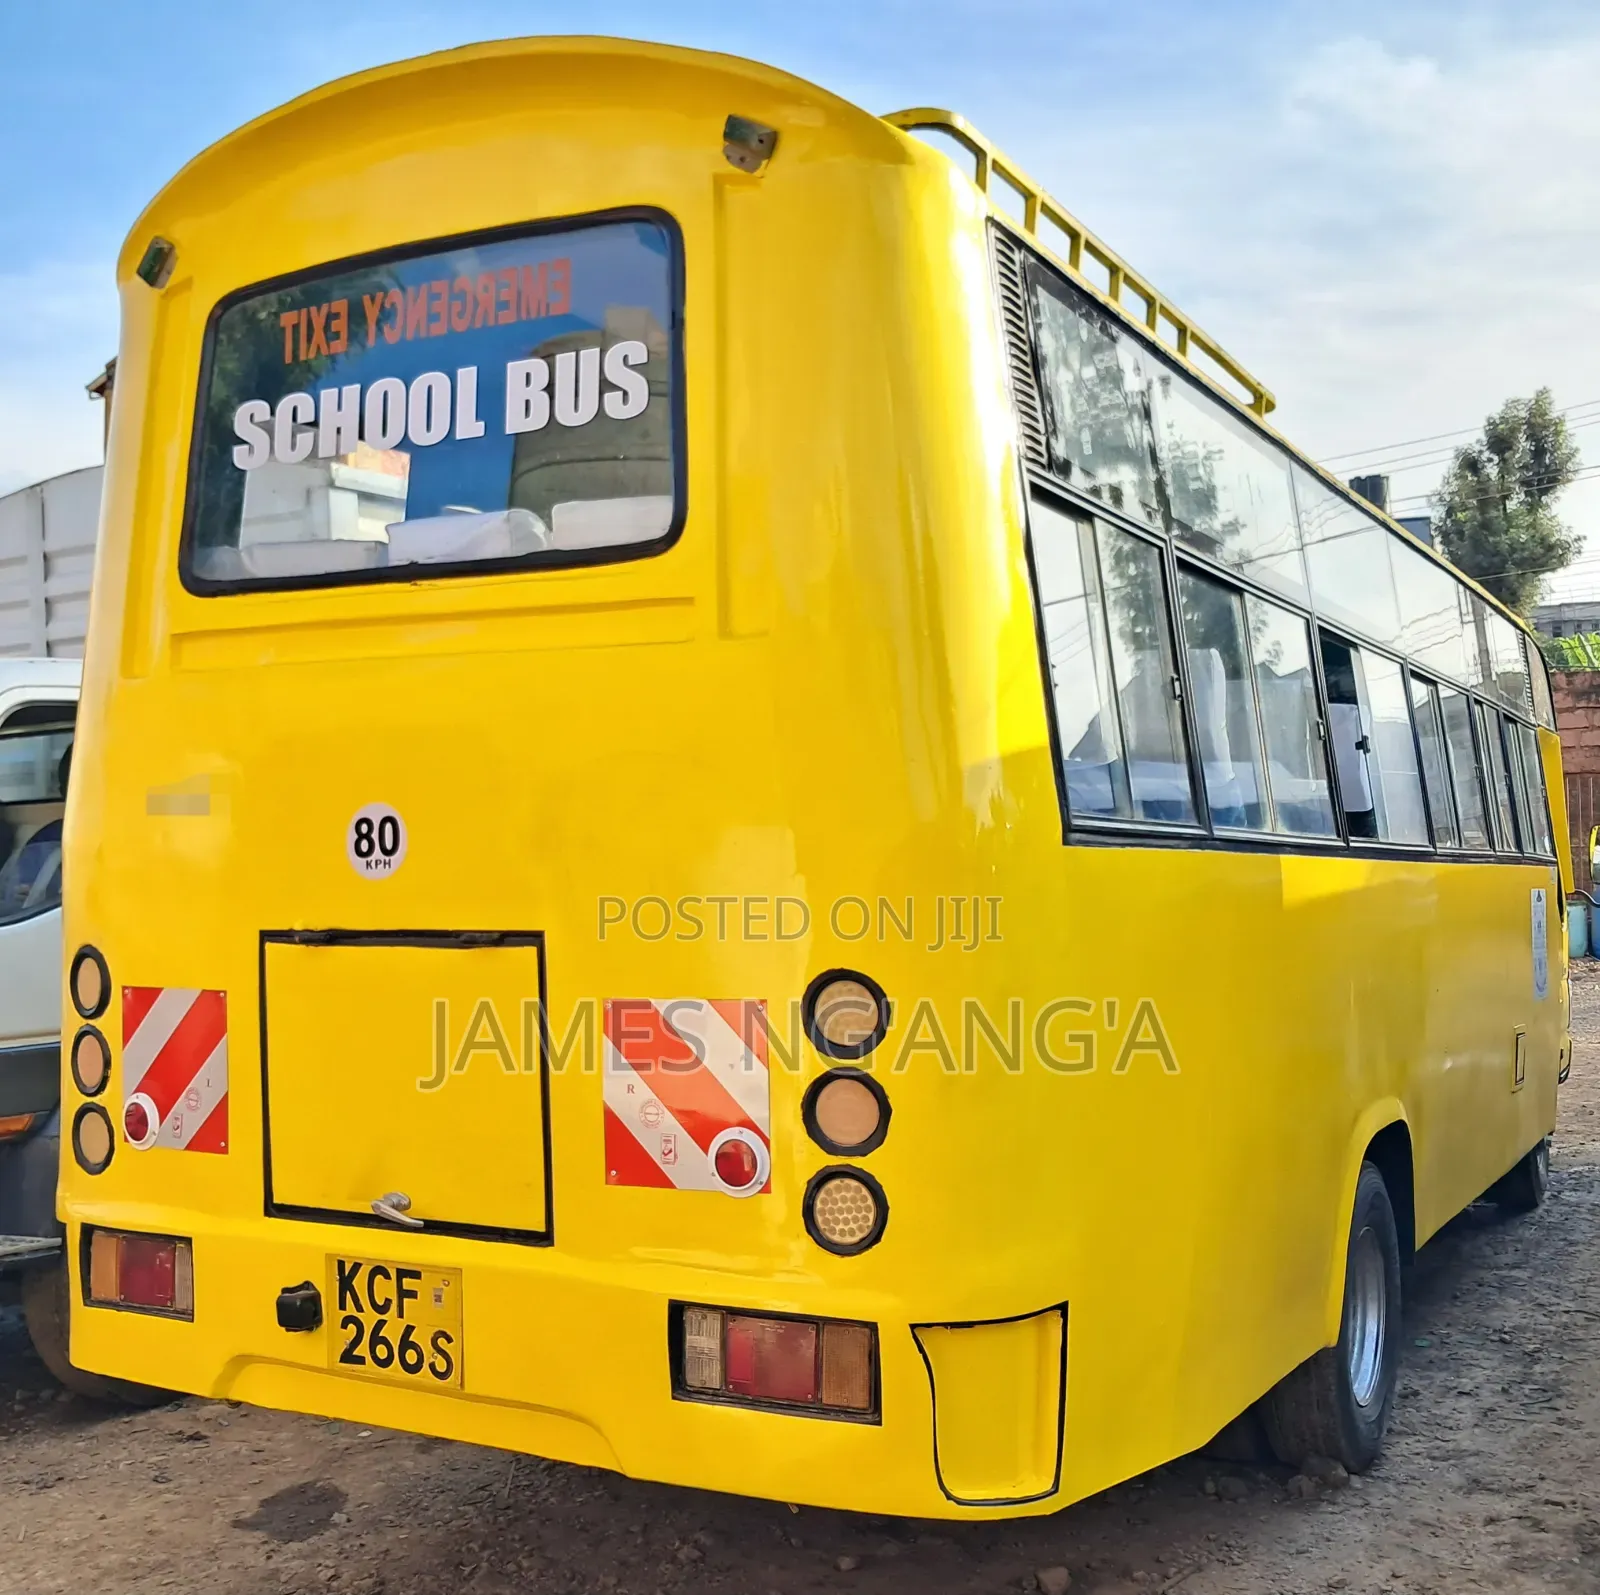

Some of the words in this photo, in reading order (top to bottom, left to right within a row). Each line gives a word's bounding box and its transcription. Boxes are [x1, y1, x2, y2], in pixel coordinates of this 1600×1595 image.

[232, 366, 485, 471] SCHOOL
[505, 340, 649, 435] BUS
[354, 815, 400, 858] 80
[365, 858, 392, 870] KPH
[627, 1083, 635, 1094] R
[337, 1259, 422, 1319] KCF
[338, 1315, 454, 1381] 266S
